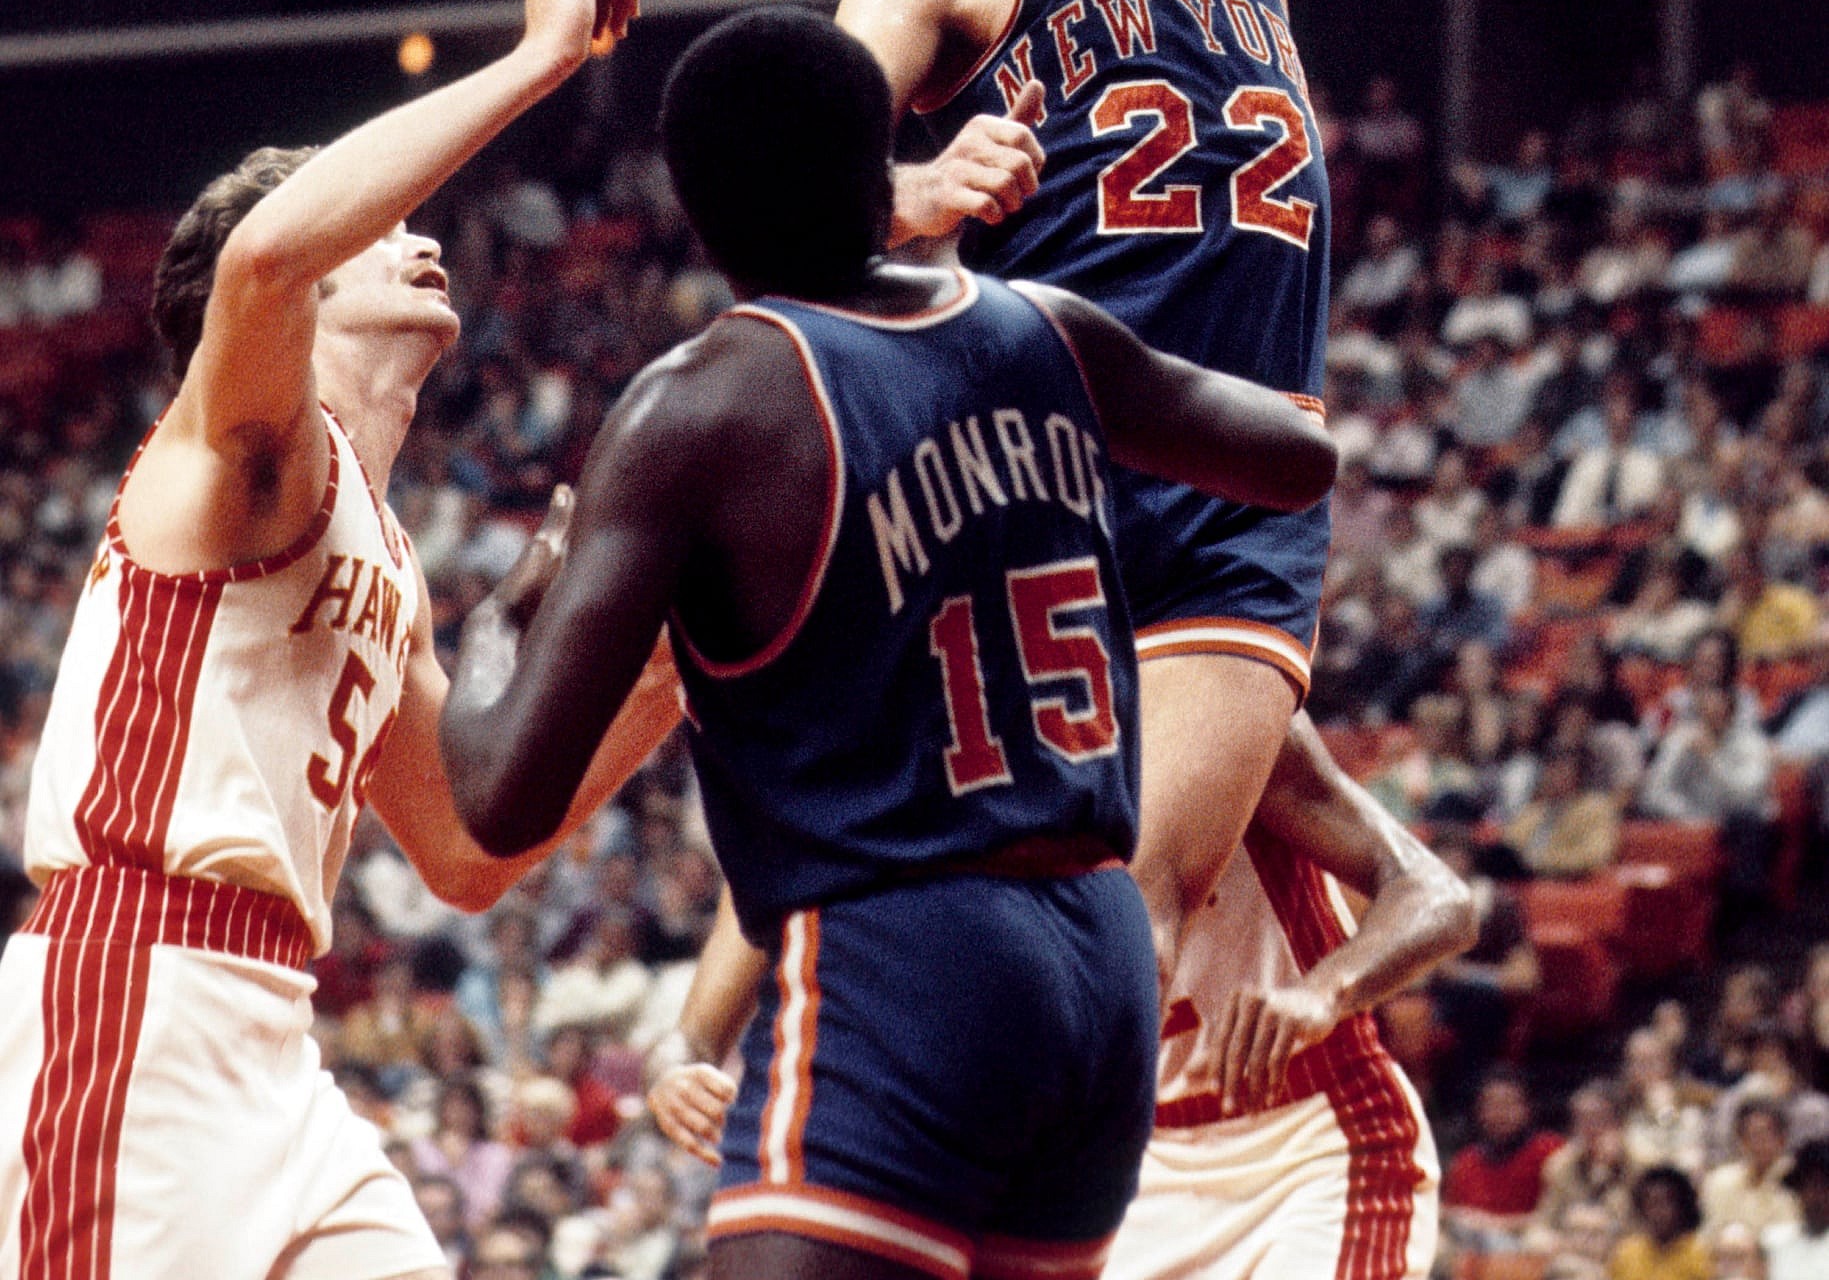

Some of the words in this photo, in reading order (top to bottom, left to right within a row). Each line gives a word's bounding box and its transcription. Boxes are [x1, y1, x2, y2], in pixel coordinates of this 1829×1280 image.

[1088, 78, 1318, 252] 22
[289, 553, 411, 675] HAW
[930, 554, 1121, 798] 15
